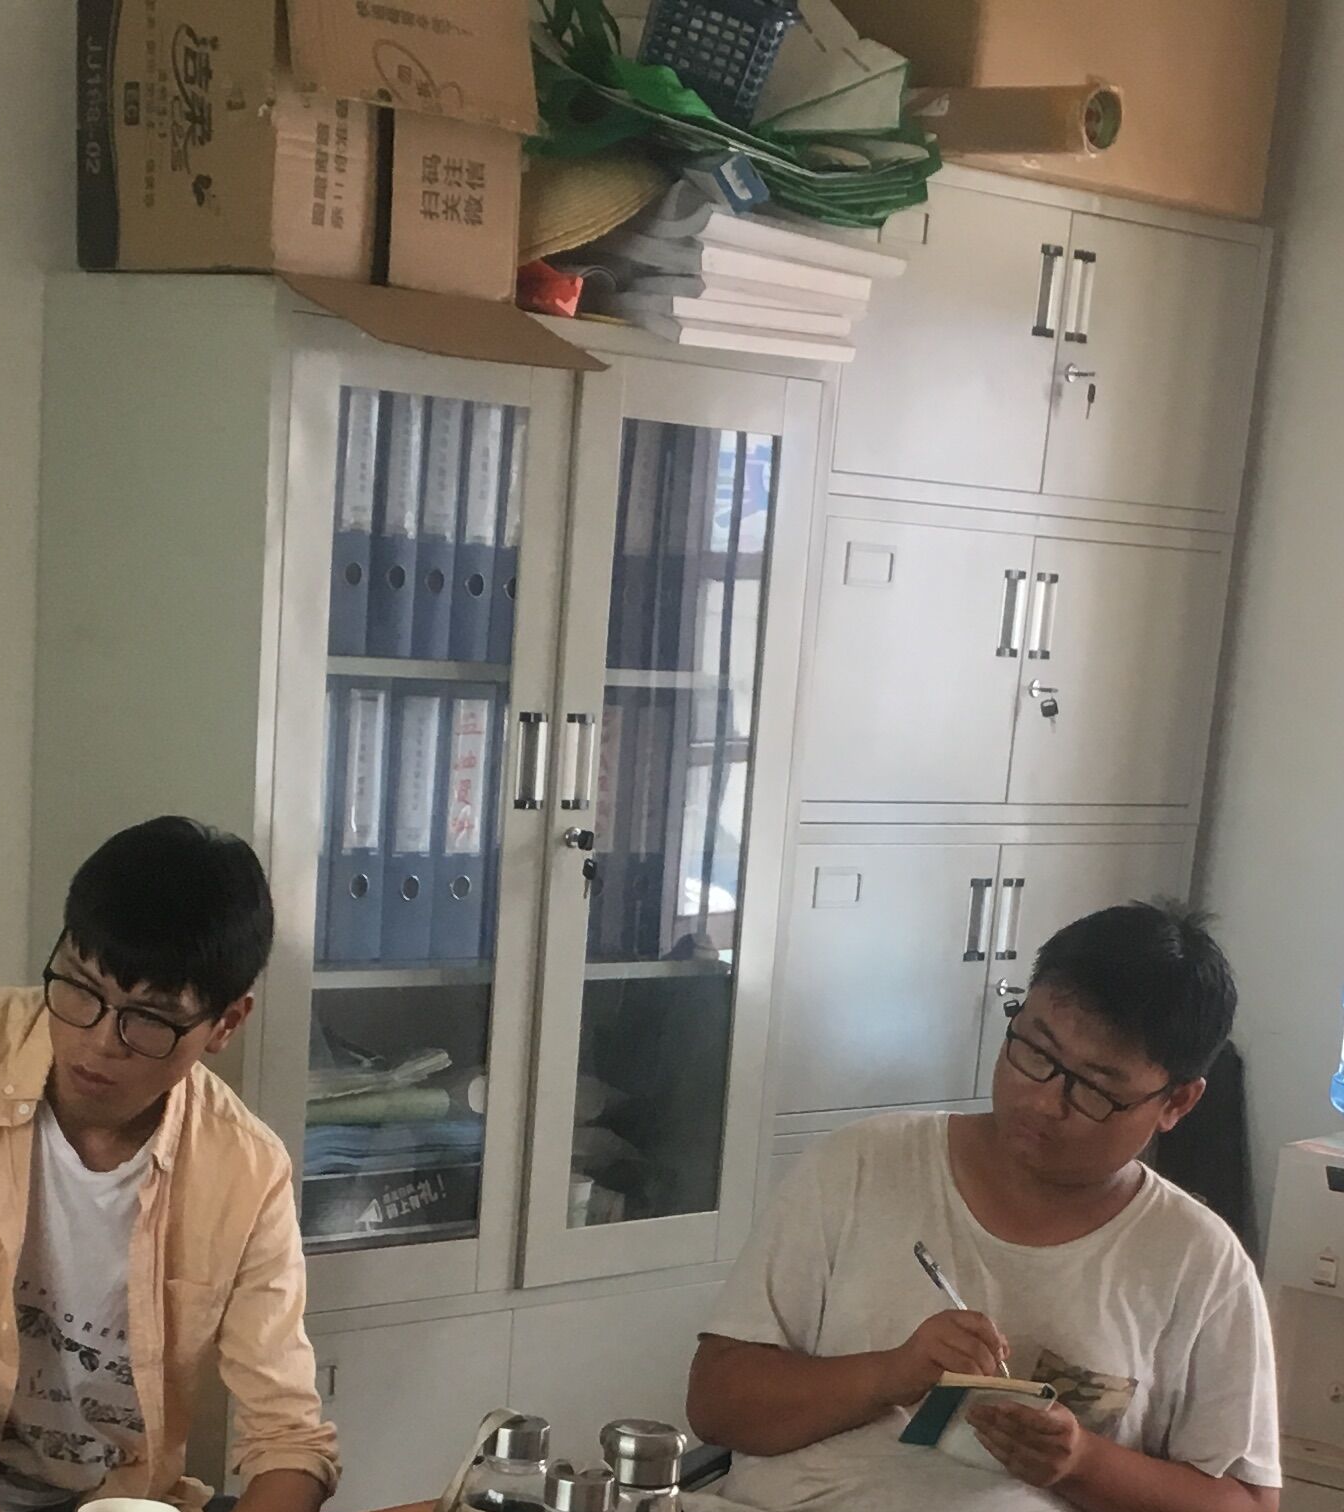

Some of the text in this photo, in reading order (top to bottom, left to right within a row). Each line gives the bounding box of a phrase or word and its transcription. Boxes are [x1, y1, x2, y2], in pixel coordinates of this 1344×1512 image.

[420, 153, 442, 222] 扫码
[442, 157, 464, 223] 关注
[464, 159, 486, 226] 微信
